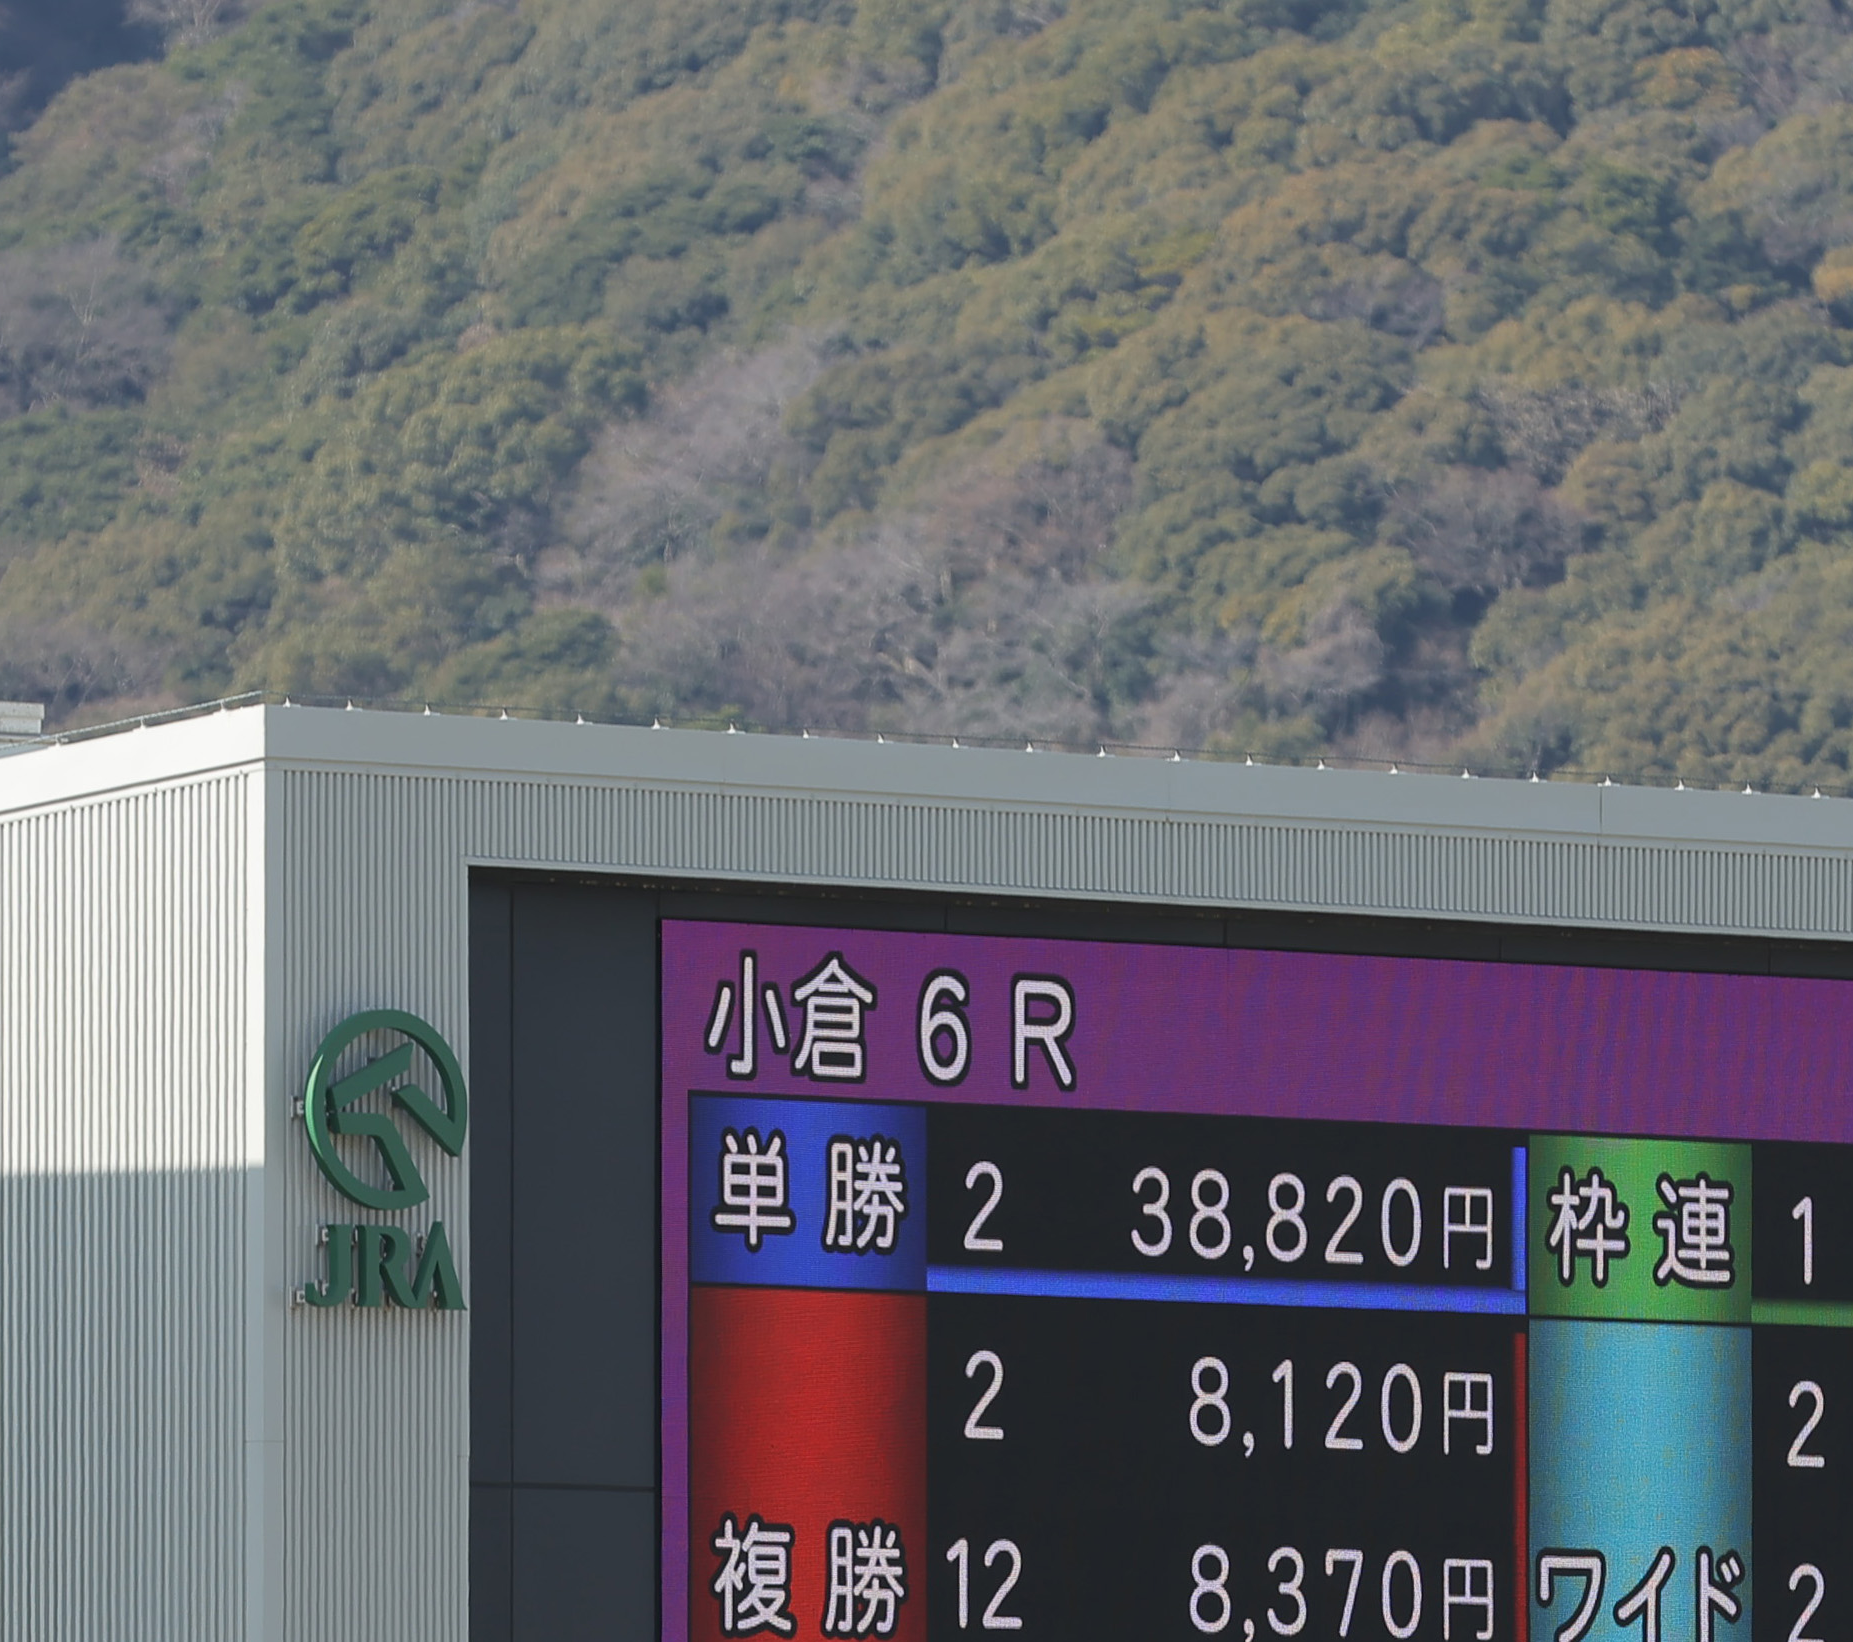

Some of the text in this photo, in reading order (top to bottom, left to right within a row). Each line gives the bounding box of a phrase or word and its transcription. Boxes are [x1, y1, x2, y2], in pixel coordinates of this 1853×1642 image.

[709, 957, 1071, 1084] 小倉 6 R
[716, 1135, 1492, 1270] 単勝 2 38,820円
[1550, 1174, 1730, 1281] 枠連
[1793, 1198, 1811, 1283] 1
[304, 1221, 468, 1311] JRA
[965, 1351, 1492, 1456] 2 8,120円
[1788, 1382, 1824, 1467] 2
[715, 1520, 903, 1632] 複勝
[947, 1539, 1022, 1628] 12
